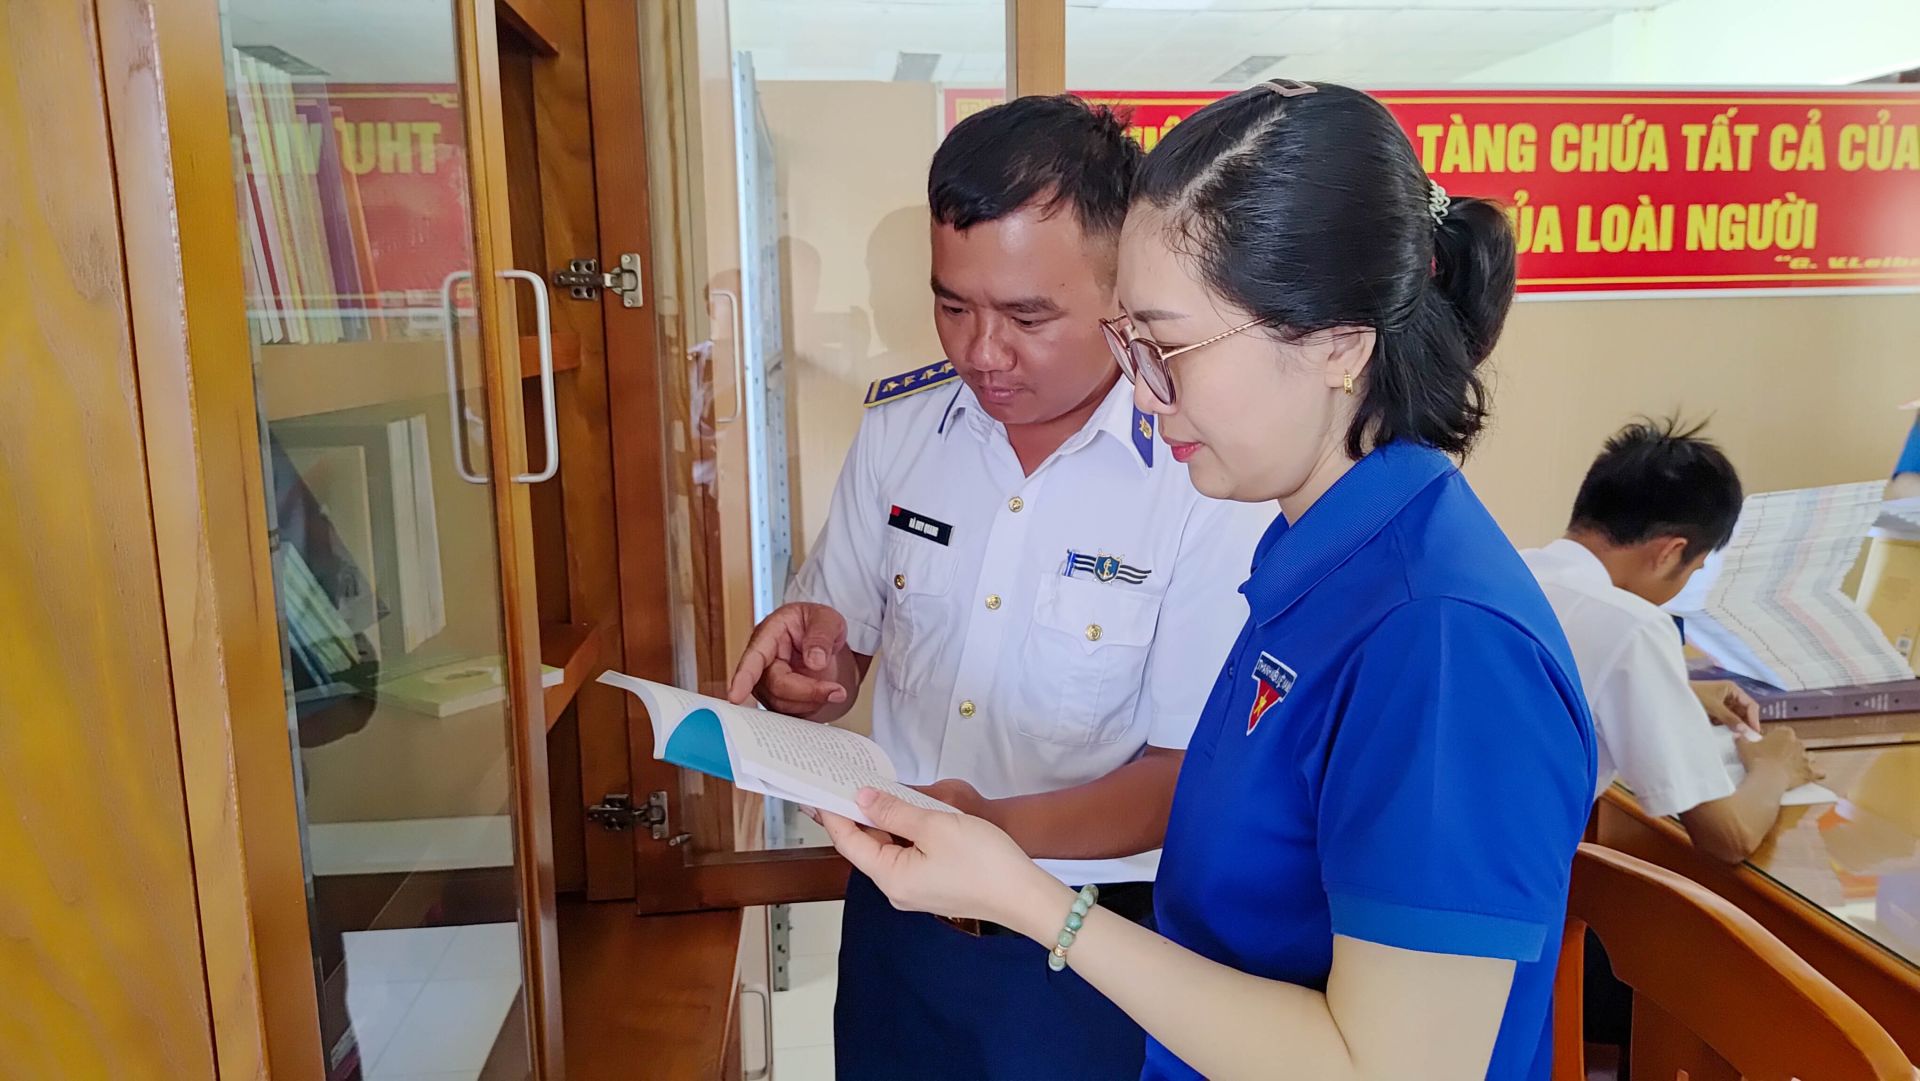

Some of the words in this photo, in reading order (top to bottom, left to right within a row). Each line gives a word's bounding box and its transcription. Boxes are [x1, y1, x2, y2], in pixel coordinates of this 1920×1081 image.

[1416, 114, 1537, 173] TÀNG
[1551, 114, 1670, 172] CHỨA
[1682, 107, 1759, 171] TẤT
[1769, 109, 1827, 171] CẢ
[1839, 109, 1920, 171] CỦA
[1507, 189, 1564, 254] ỦA
[1577, 195, 1675, 253] LOÀI
[1686, 193, 1818, 251] NGƯỜI
